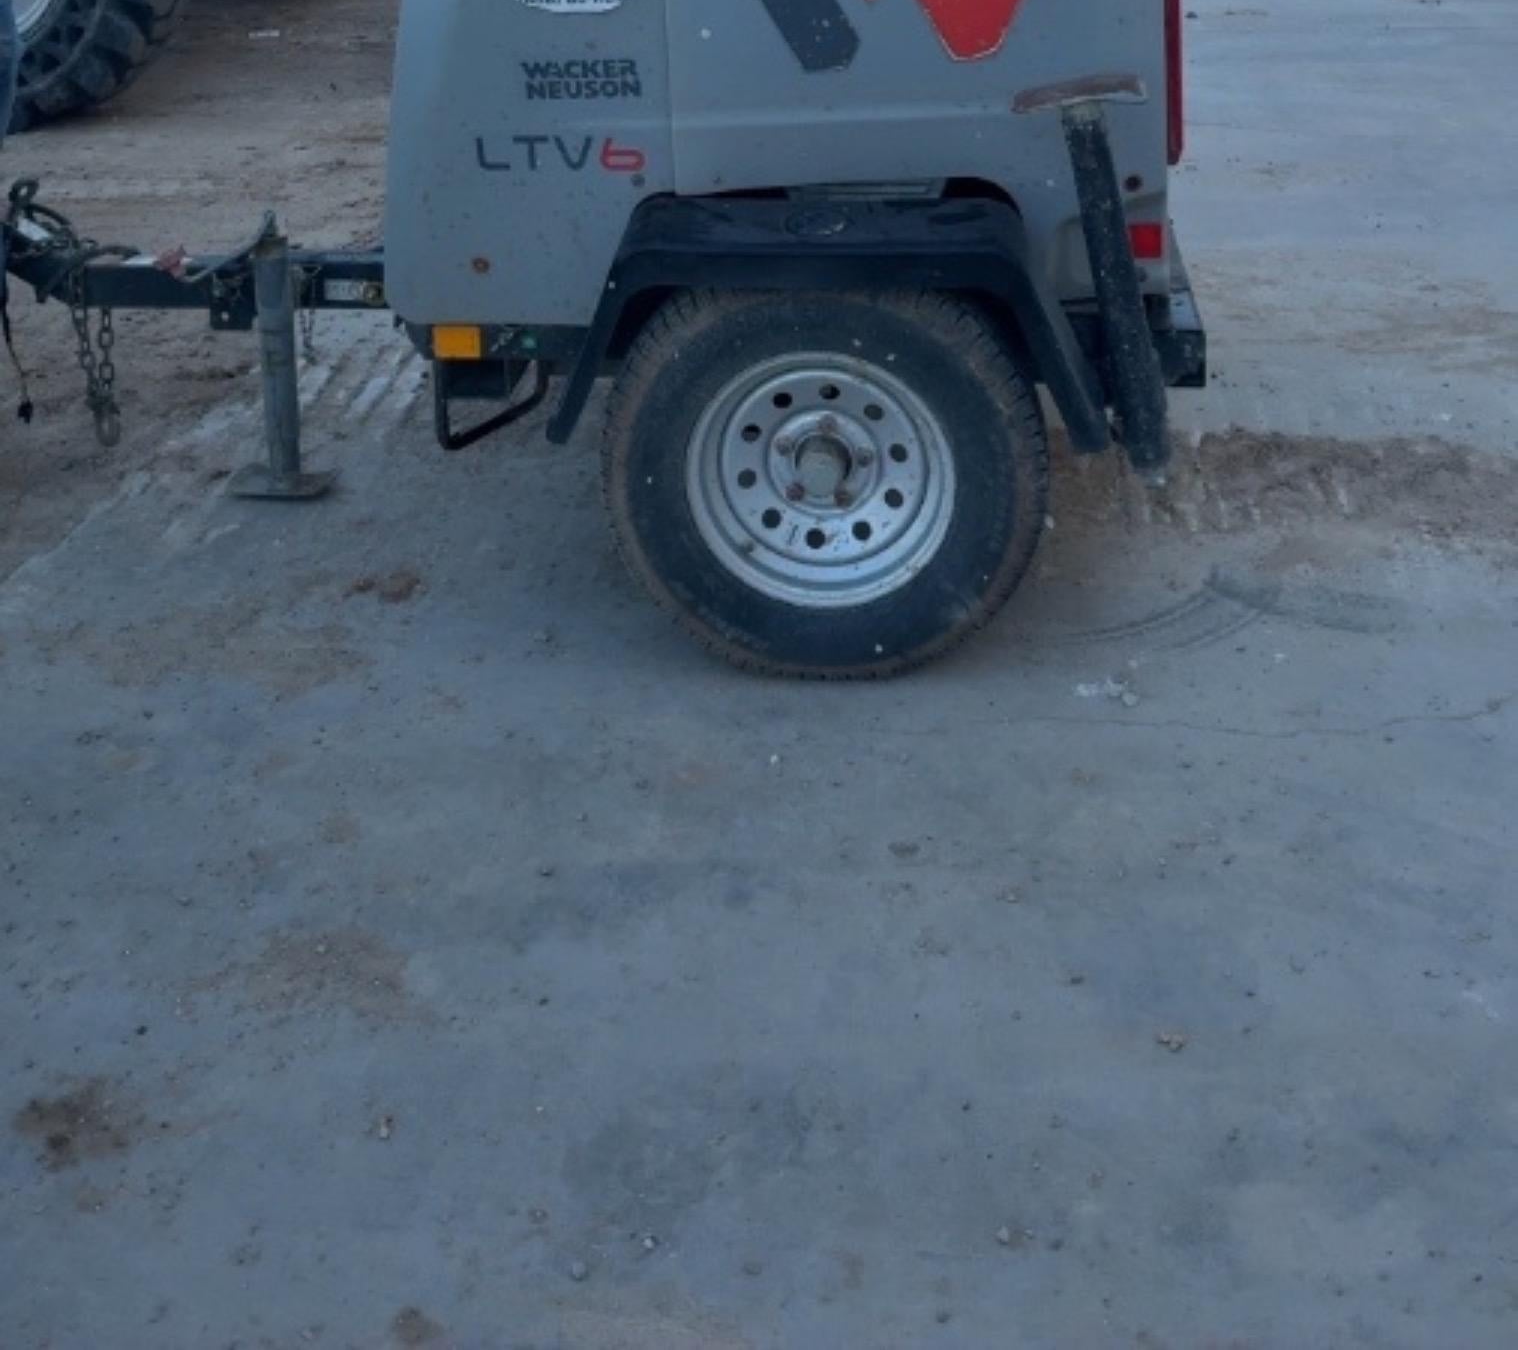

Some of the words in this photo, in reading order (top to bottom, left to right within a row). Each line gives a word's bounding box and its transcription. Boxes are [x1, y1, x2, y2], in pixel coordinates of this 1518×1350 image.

[521, 59, 637, 79] WACKER
[525, 77, 643, 100] NEUSON
[476, 135, 646, 172] LTV6
